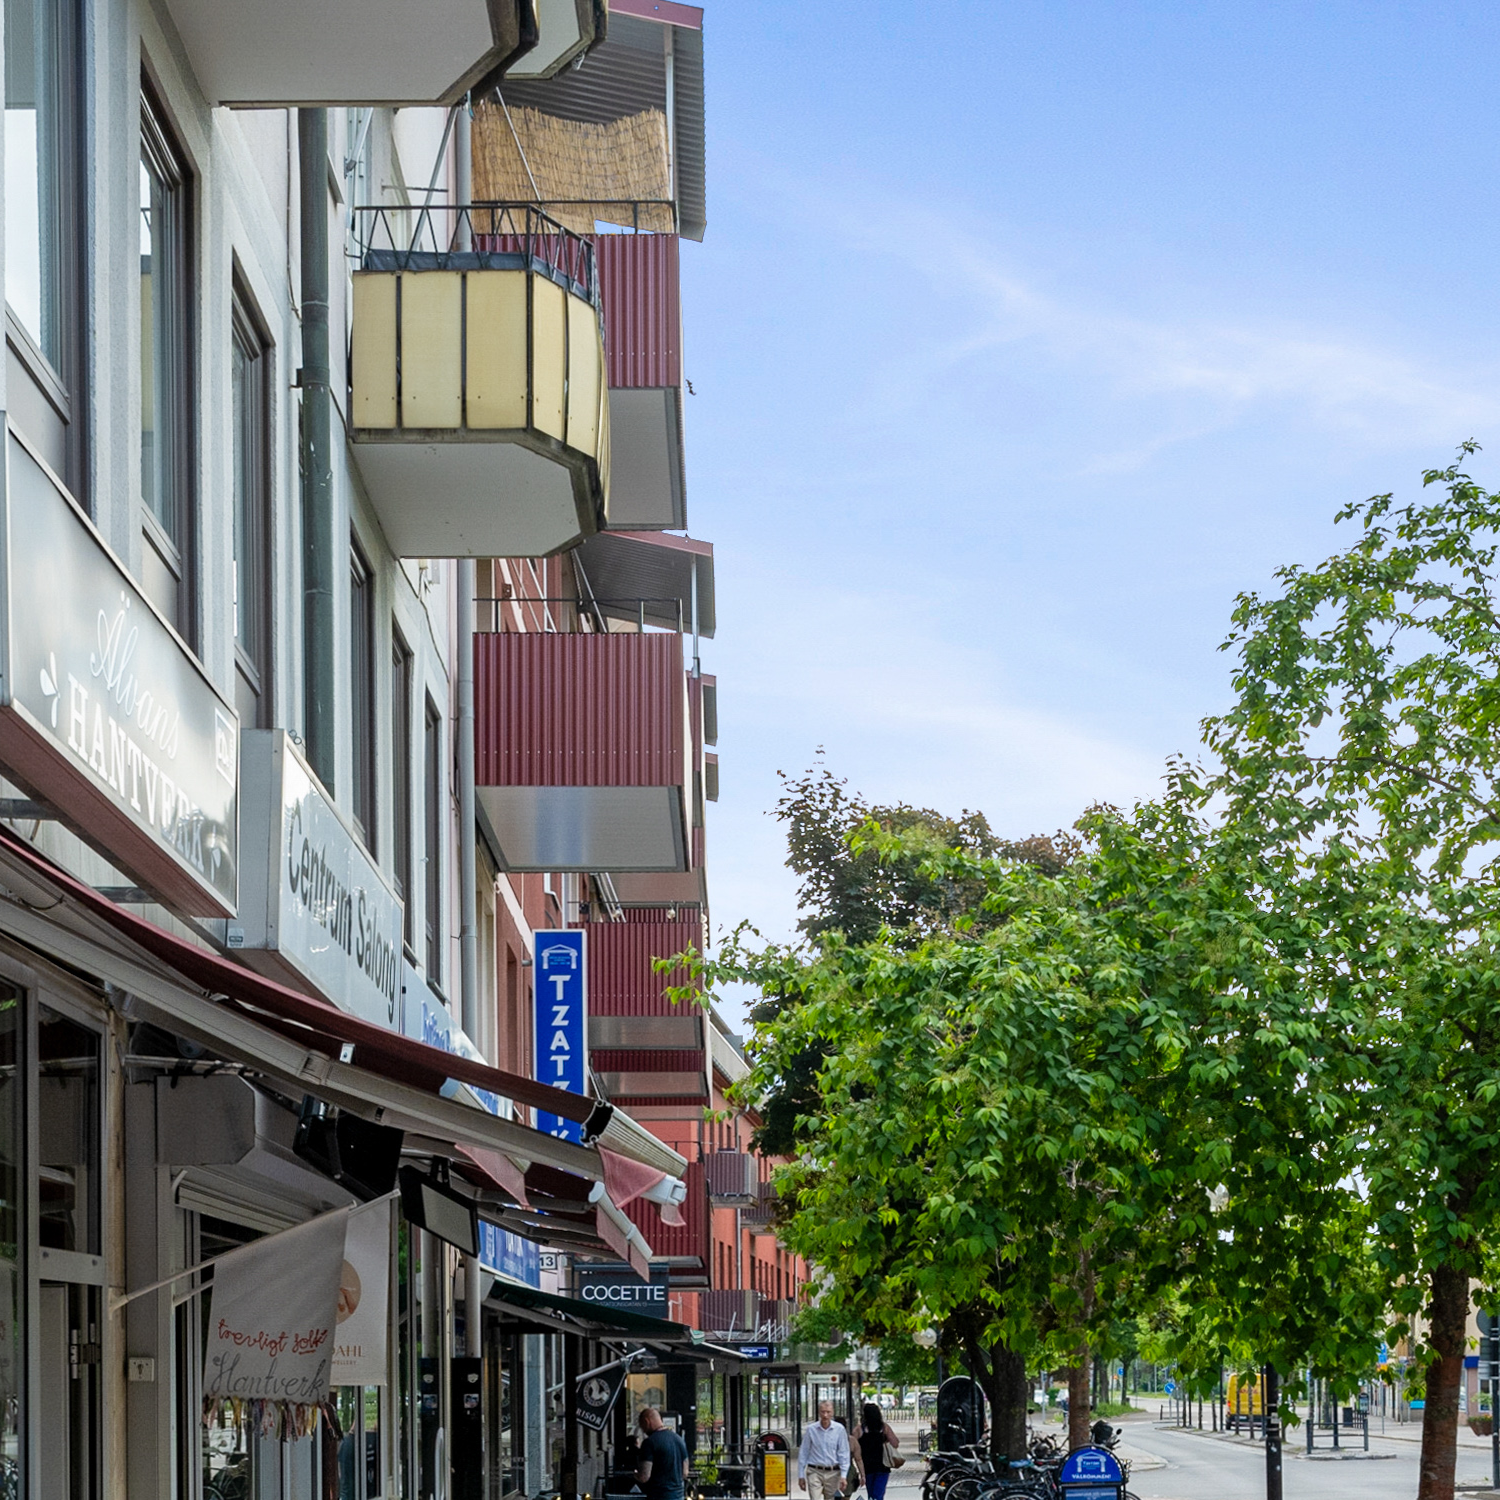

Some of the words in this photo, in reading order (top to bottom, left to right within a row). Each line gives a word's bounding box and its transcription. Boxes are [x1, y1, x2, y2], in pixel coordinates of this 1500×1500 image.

[67, 671, 205, 874] HANTVERK
[288, 797, 352, 956] Centrum
[356, 887, 396, 1024] Salong
[539, 1256, 554, 1267] 13
[582, 1285, 666, 1301] COCETTE
[217, 1318, 289, 1358] trevligt
[575, 1407, 602, 1425] RISÖR
